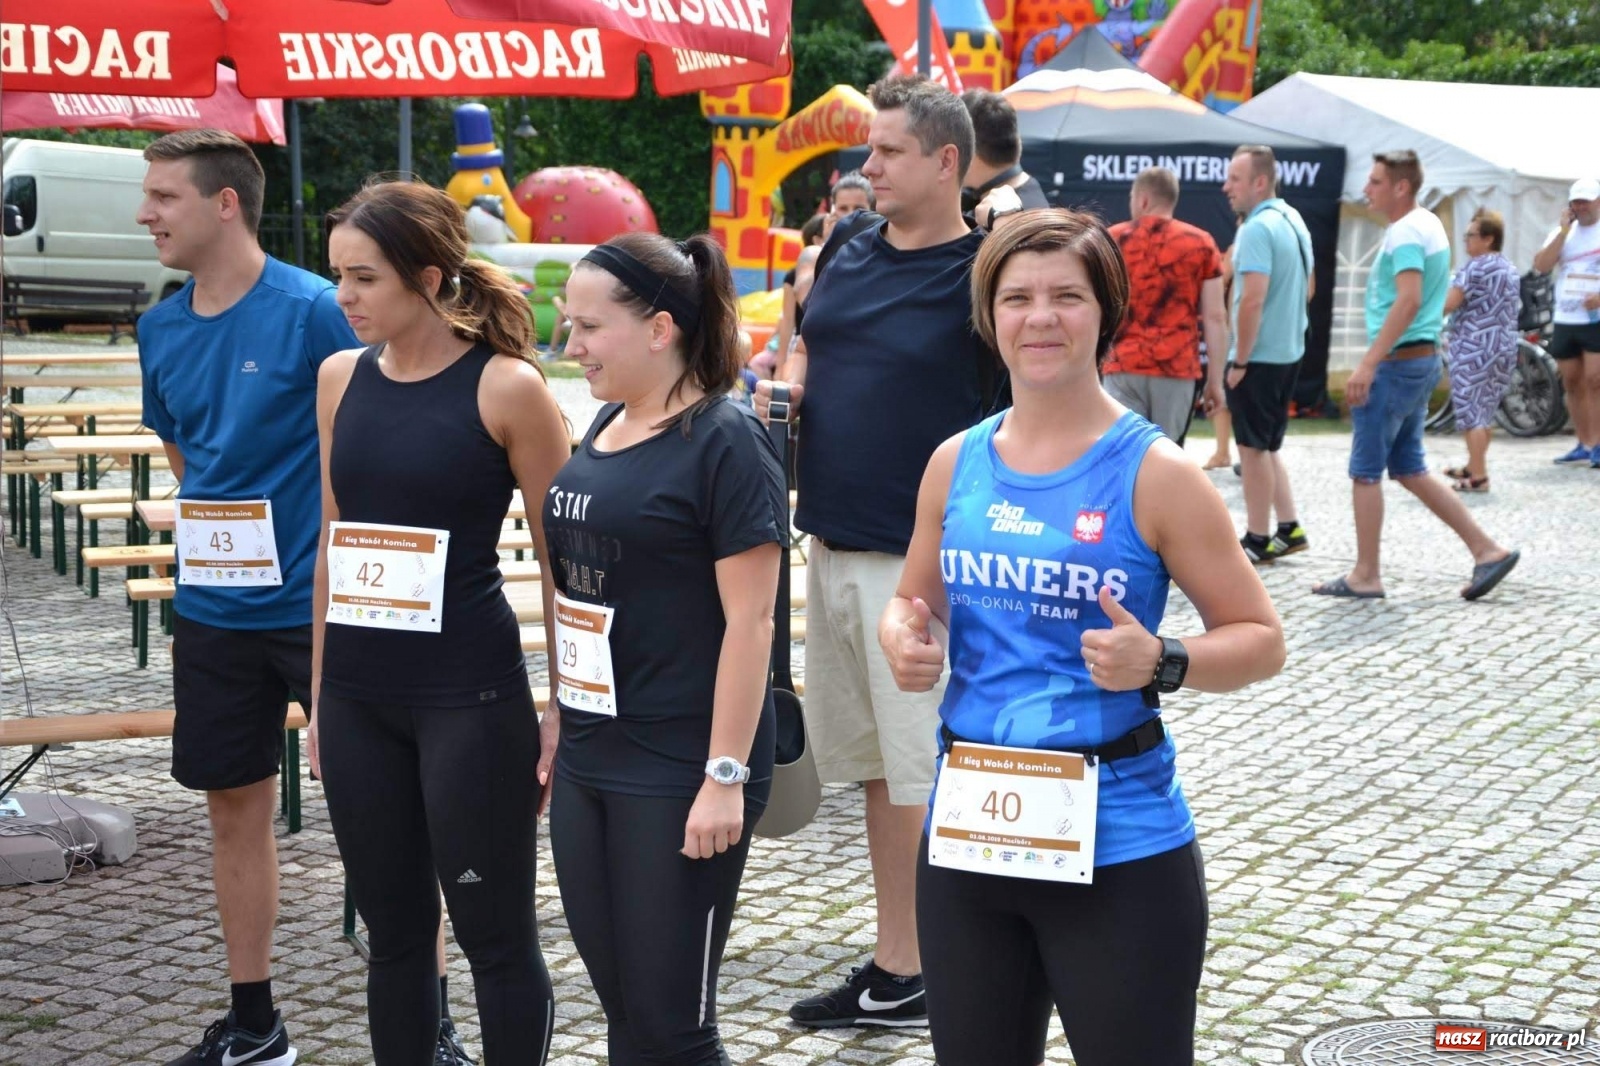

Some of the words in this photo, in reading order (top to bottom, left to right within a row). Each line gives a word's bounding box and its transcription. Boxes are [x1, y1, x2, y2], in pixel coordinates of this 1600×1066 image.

[1083, 154, 1153, 181] SKLEP
[210, 531, 234, 553] 43
[383, 538, 418, 548] Komina
[356, 561, 385, 588] 42
[1030, 602, 1079, 620] TEAM
[562, 639, 577, 668] 29
[964, 757, 981, 769] Bieg
[983, 758, 1014, 770] Wokół
[1017, 760, 1062, 774] Komina
[981, 790, 1022, 823] 40
